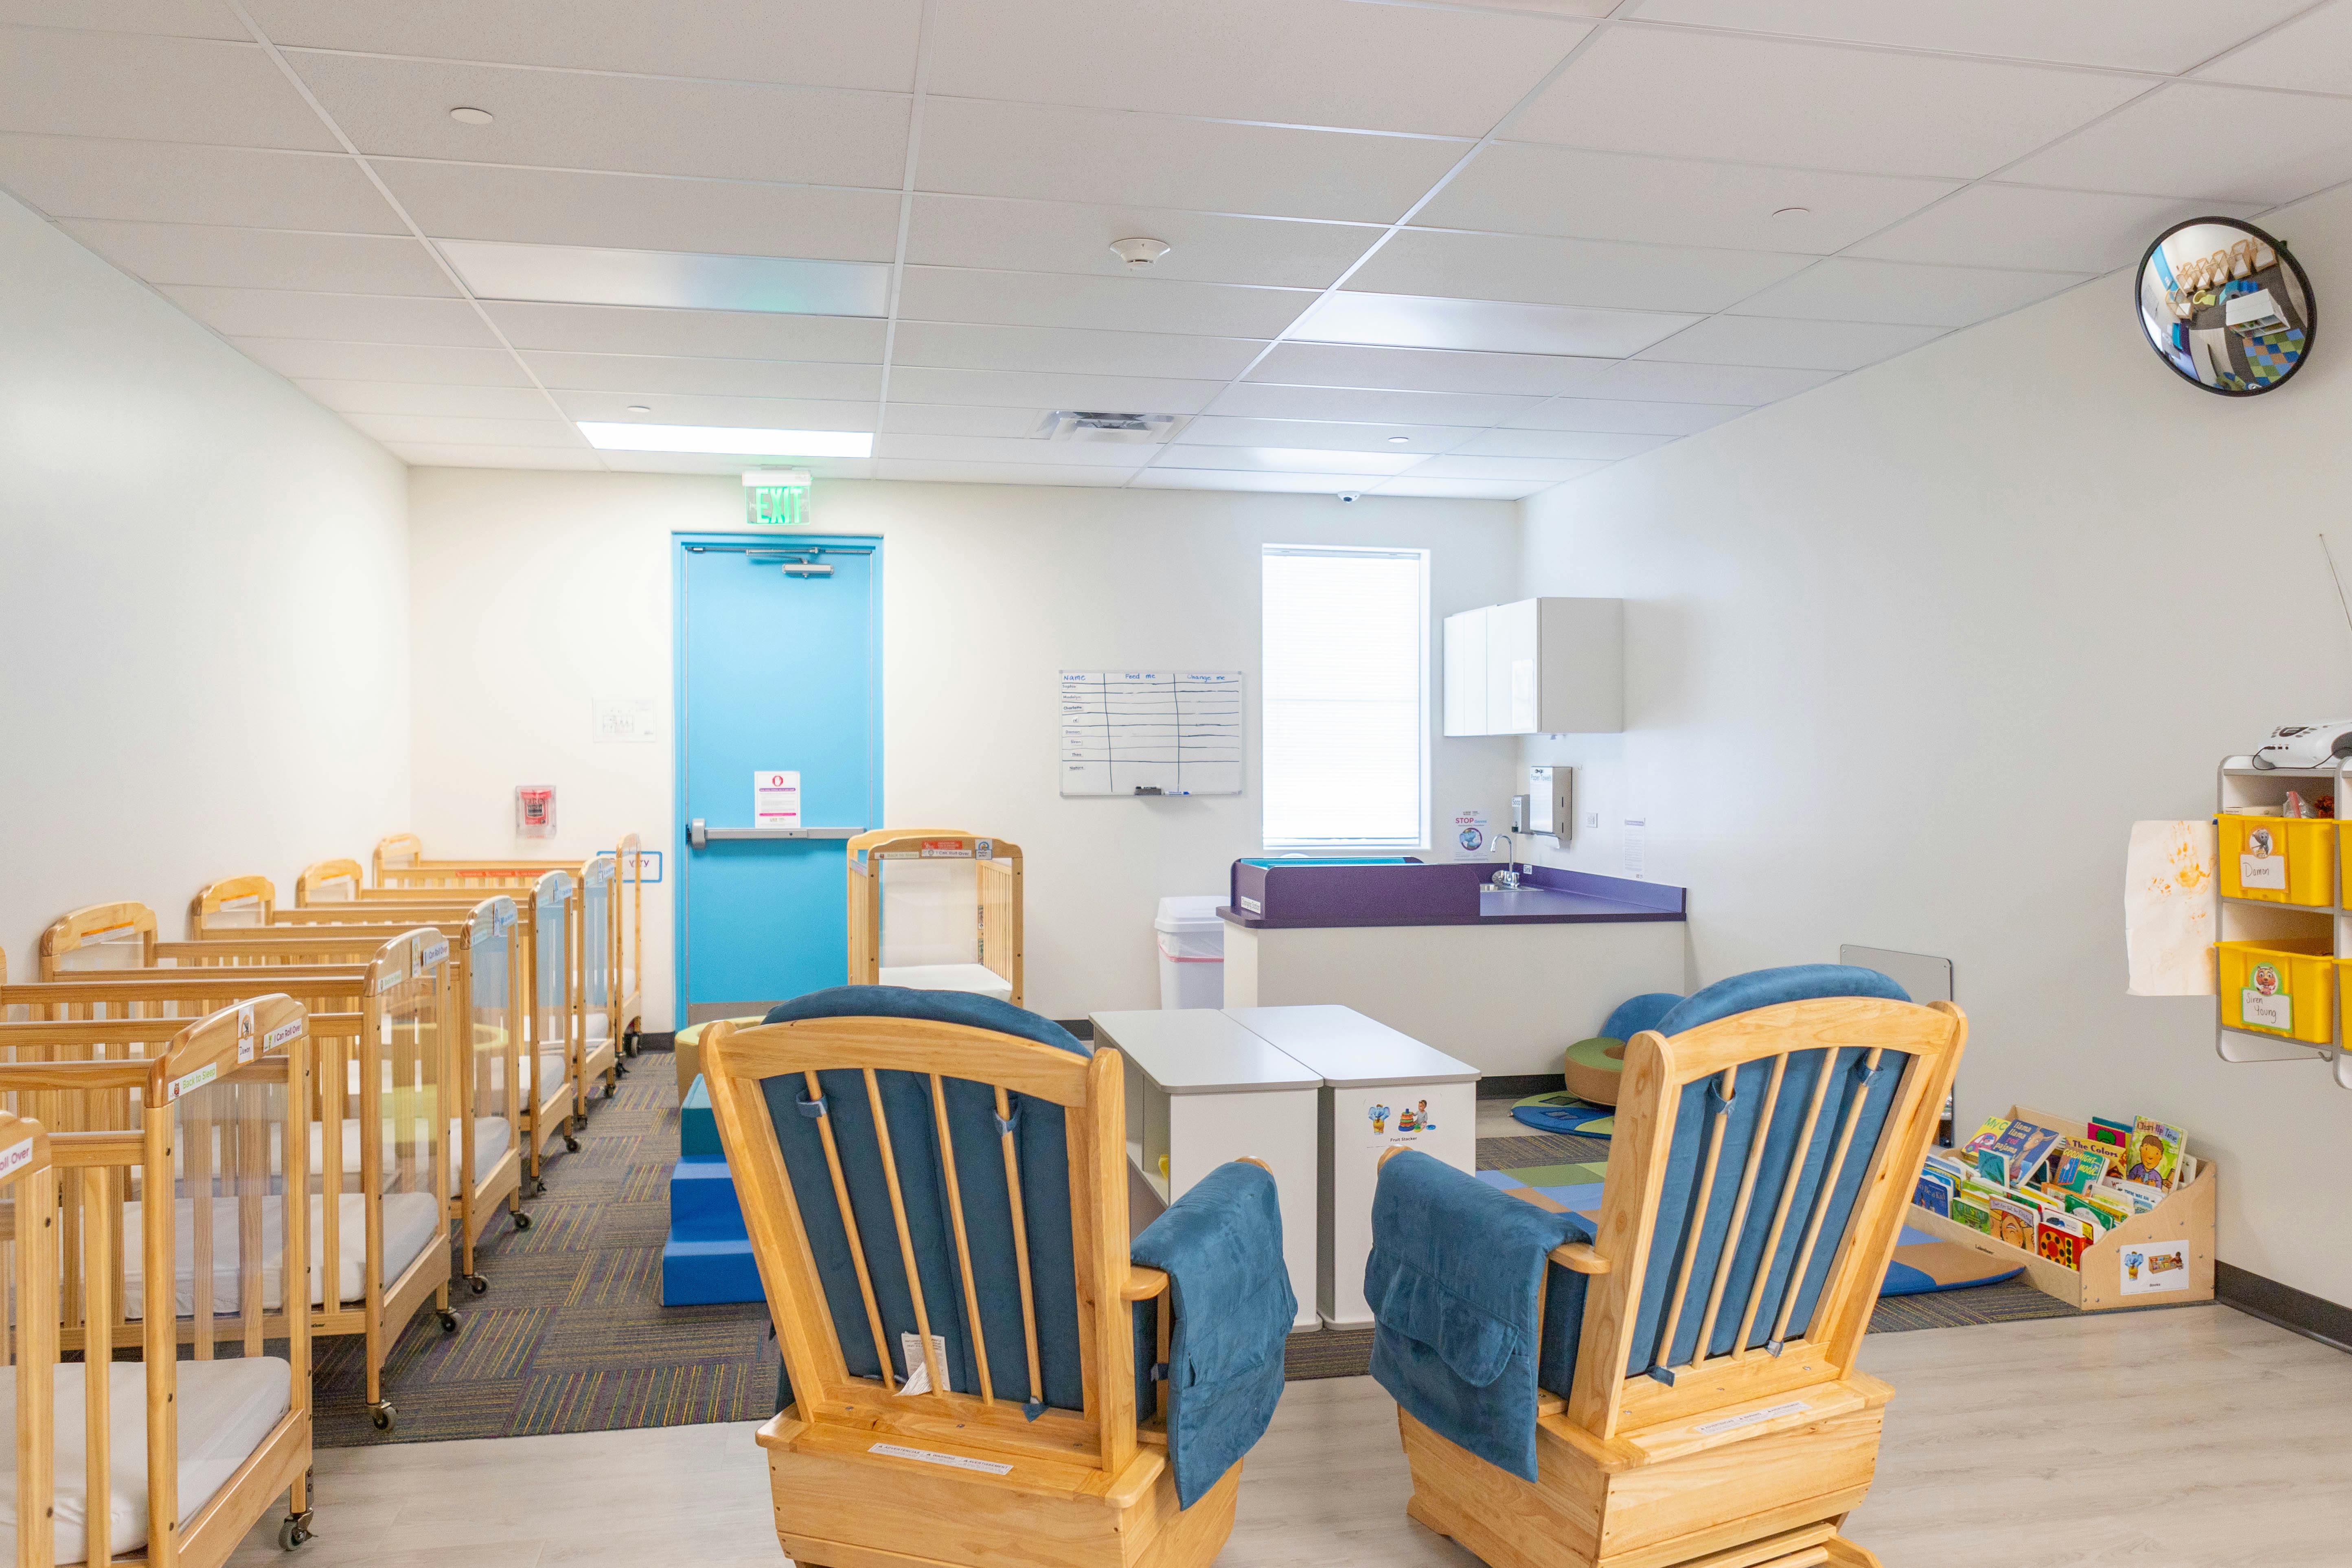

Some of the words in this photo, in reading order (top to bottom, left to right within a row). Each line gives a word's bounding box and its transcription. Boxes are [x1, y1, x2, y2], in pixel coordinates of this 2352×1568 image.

[756, 487, 803, 523] EXIT
[1187, 674, 1211, 682] Change
[2242, 862, 2269, 877] Damon
[2246, 993, 2263, 1004] Siren
[2254, 1004, 2276, 1024] Young
[292, 1024, 301, 1033] Over
[182, 1077, 195, 1089] Back
[195, 1074, 201, 1083] to
[202, 1068, 215, 1080] Sleep
[1985, 1117, 1999, 1129] My
[2014, 1121, 2032, 1133] llama
[2008, 1129, 2027, 1139] llama
[2165, 1128, 2178, 1143] Time
[1994, 1142, 2017, 1154] pajama
[2063, 1148, 2097, 1163] GOODNIGHT
[2073, 1140, 2088, 1150] The
[2091, 1145, 2118, 1157] Colors
[0, 1156, 9, 1171] oll
[11, 1147, 30, 1164] Over
[2078, 1164, 2097, 1175] MOON
[1925, 1185, 1931, 1194] Be
[1936, 1191, 1946, 1200] Kid
